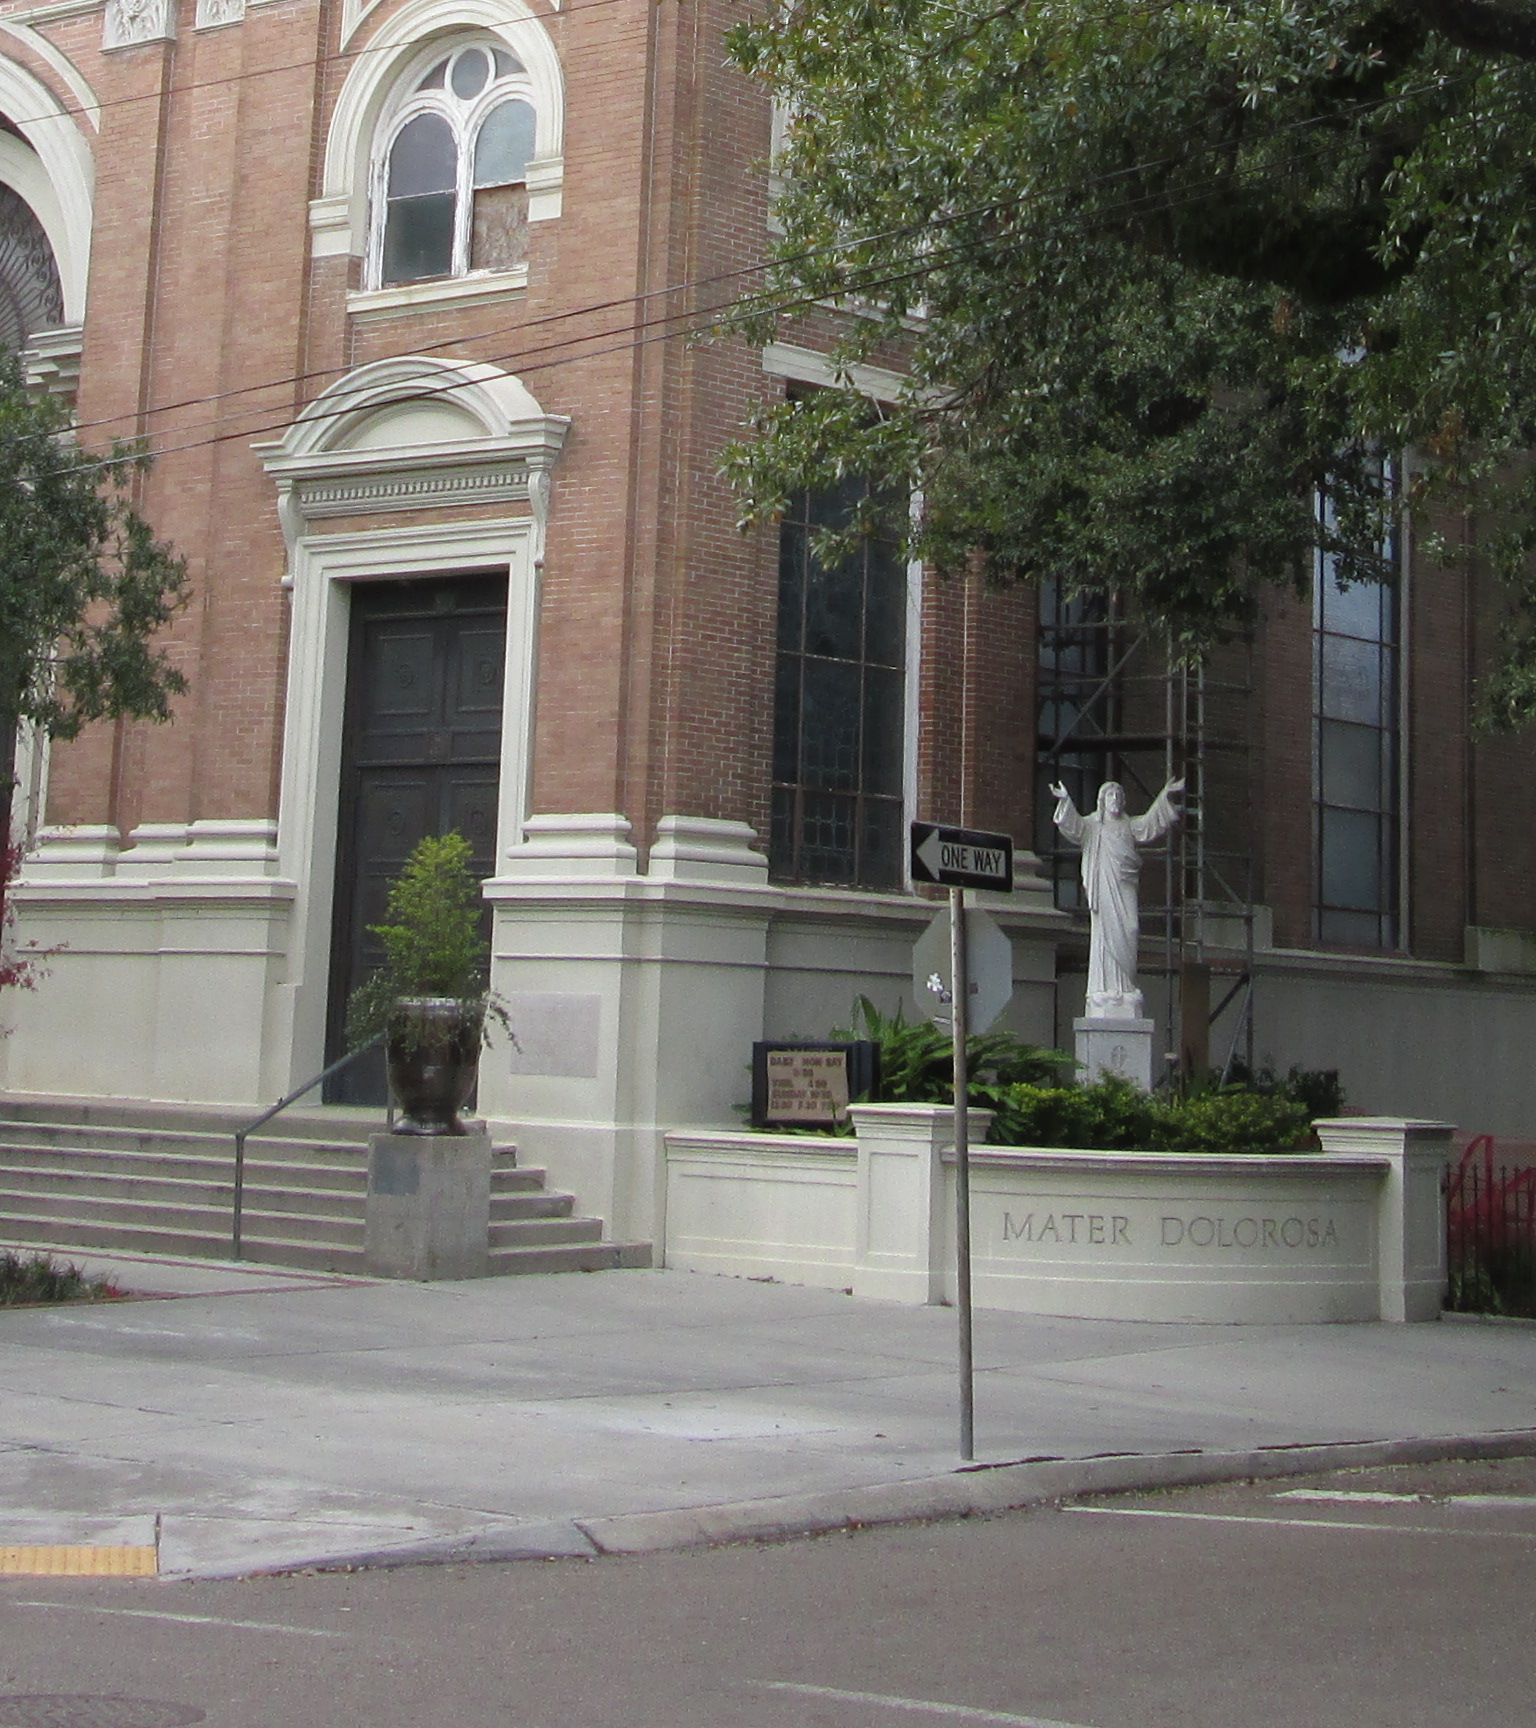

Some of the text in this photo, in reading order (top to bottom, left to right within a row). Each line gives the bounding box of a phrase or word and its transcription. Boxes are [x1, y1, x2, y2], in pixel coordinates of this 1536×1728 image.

[941, 845, 1002, 874] ONE WAY
[1001, 1211, 1341, 1249] MATER DOLOROSA
